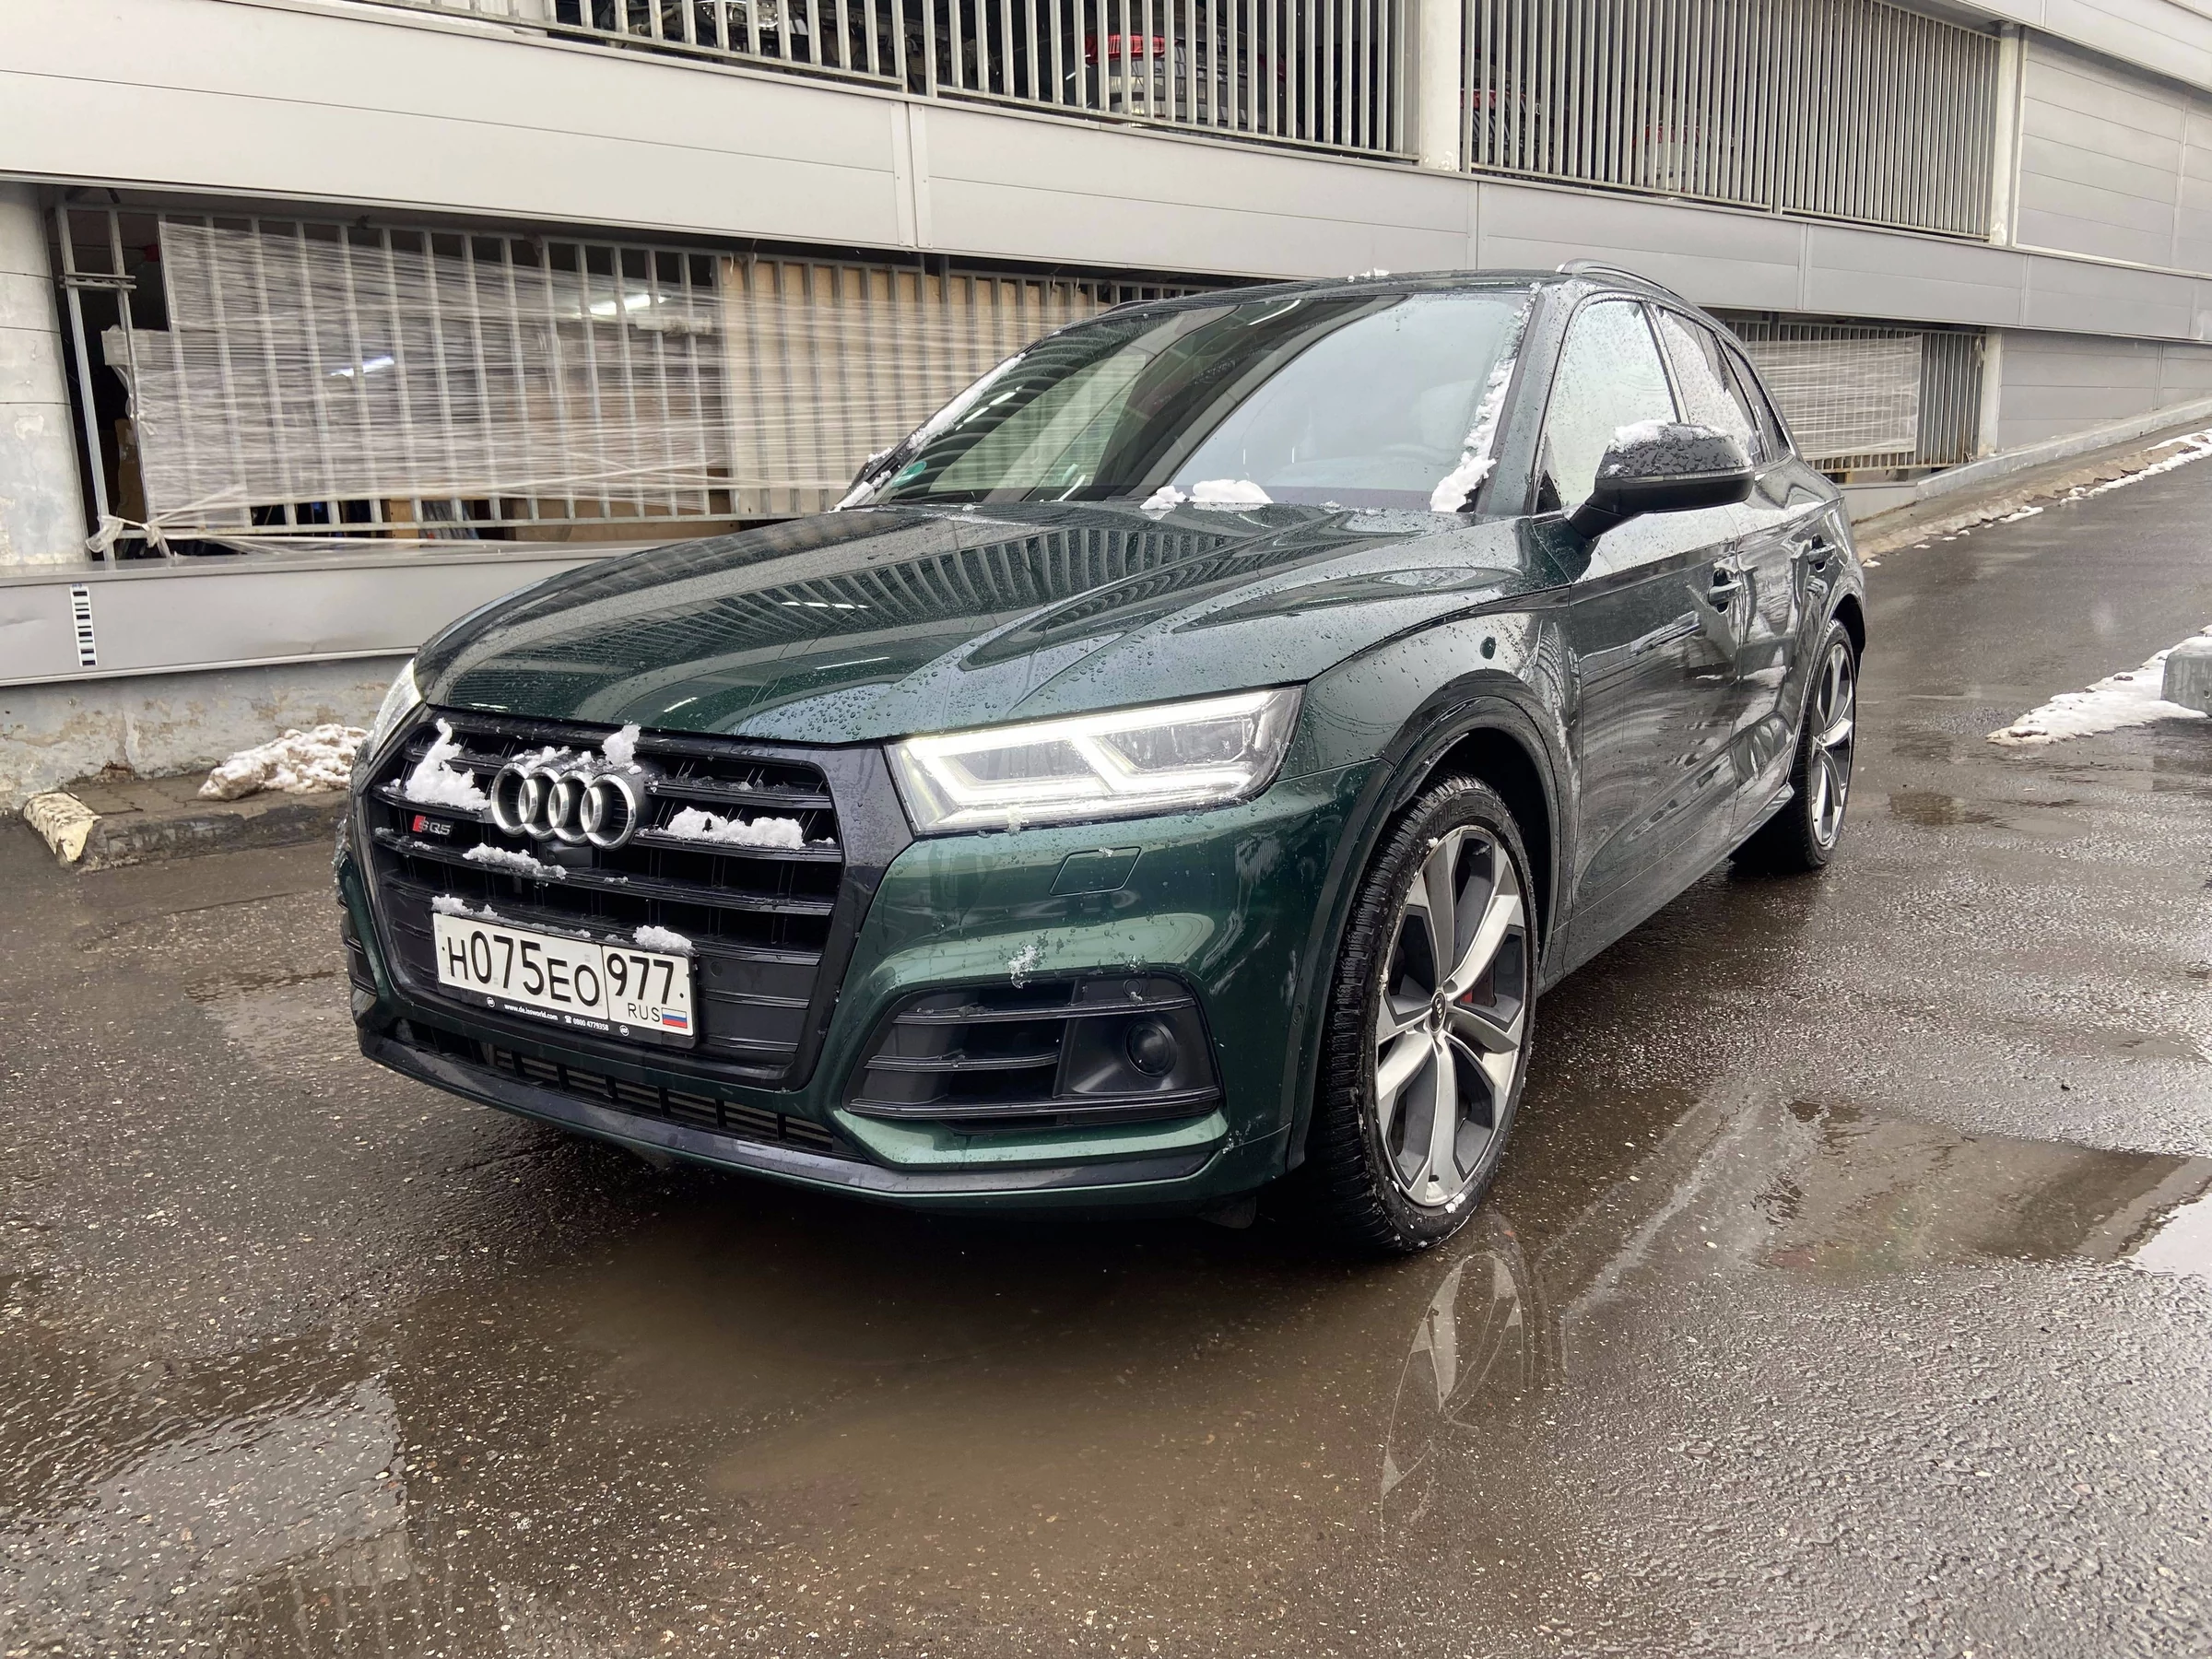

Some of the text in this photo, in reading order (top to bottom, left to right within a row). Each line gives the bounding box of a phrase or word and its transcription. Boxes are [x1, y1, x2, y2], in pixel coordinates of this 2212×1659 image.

[418, 819, 451, 836] SQ5
[446, 930, 675, 1007] H075EO 977
[627, 1002, 661, 1023] RUS
